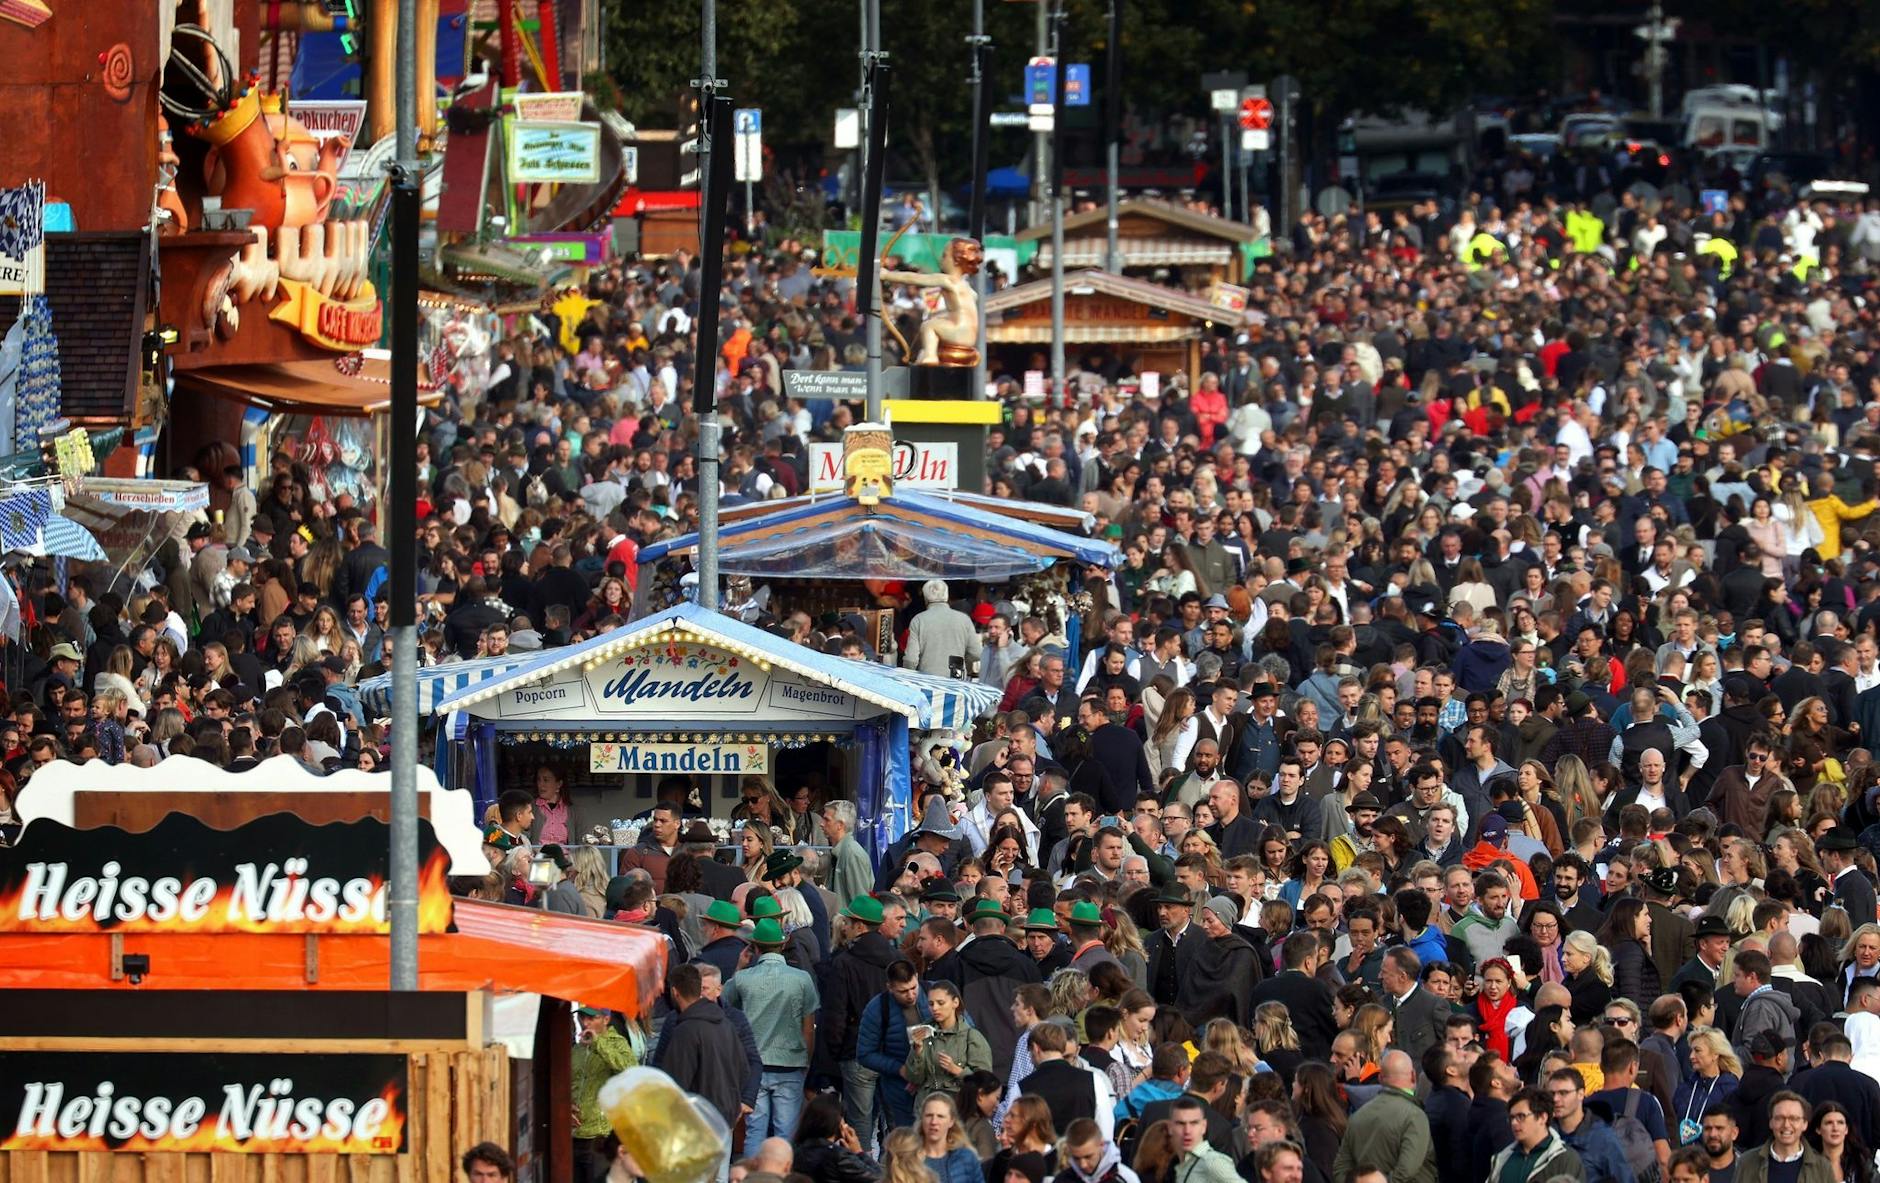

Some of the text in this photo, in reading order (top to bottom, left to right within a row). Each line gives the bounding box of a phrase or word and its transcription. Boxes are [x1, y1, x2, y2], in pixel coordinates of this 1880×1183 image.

[290, 110, 356, 133] ebkuchen
[515, 688, 566, 705] Popcorn
[603, 668, 753, 705] Mandeln
[782, 685, 845, 705] Magenbrot
[617, 745, 741, 772] Mandeln
[17, 861, 218, 922] Heisse
[15, 1077, 389, 1141] Heisse Nüsse
